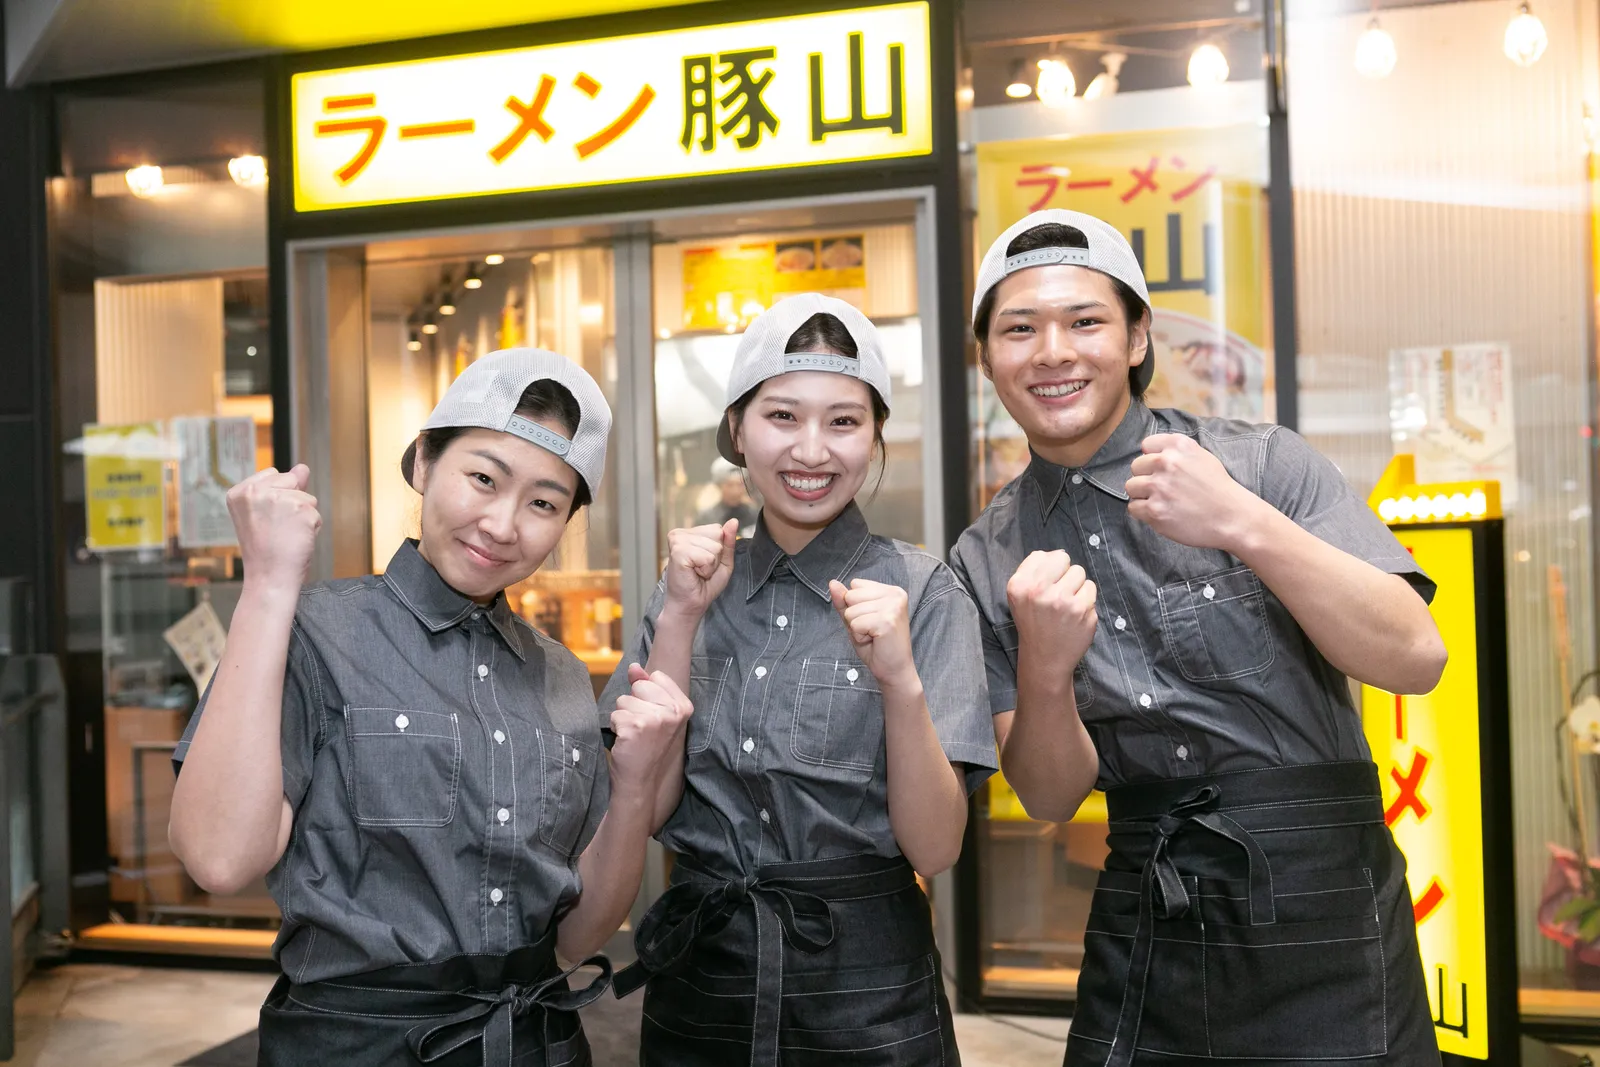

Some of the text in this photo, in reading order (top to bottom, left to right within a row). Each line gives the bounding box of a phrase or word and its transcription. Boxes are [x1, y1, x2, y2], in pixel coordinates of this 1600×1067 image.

[1016, 157, 1217, 212] ラーメン
[1132, 212, 1216, 295] 山
